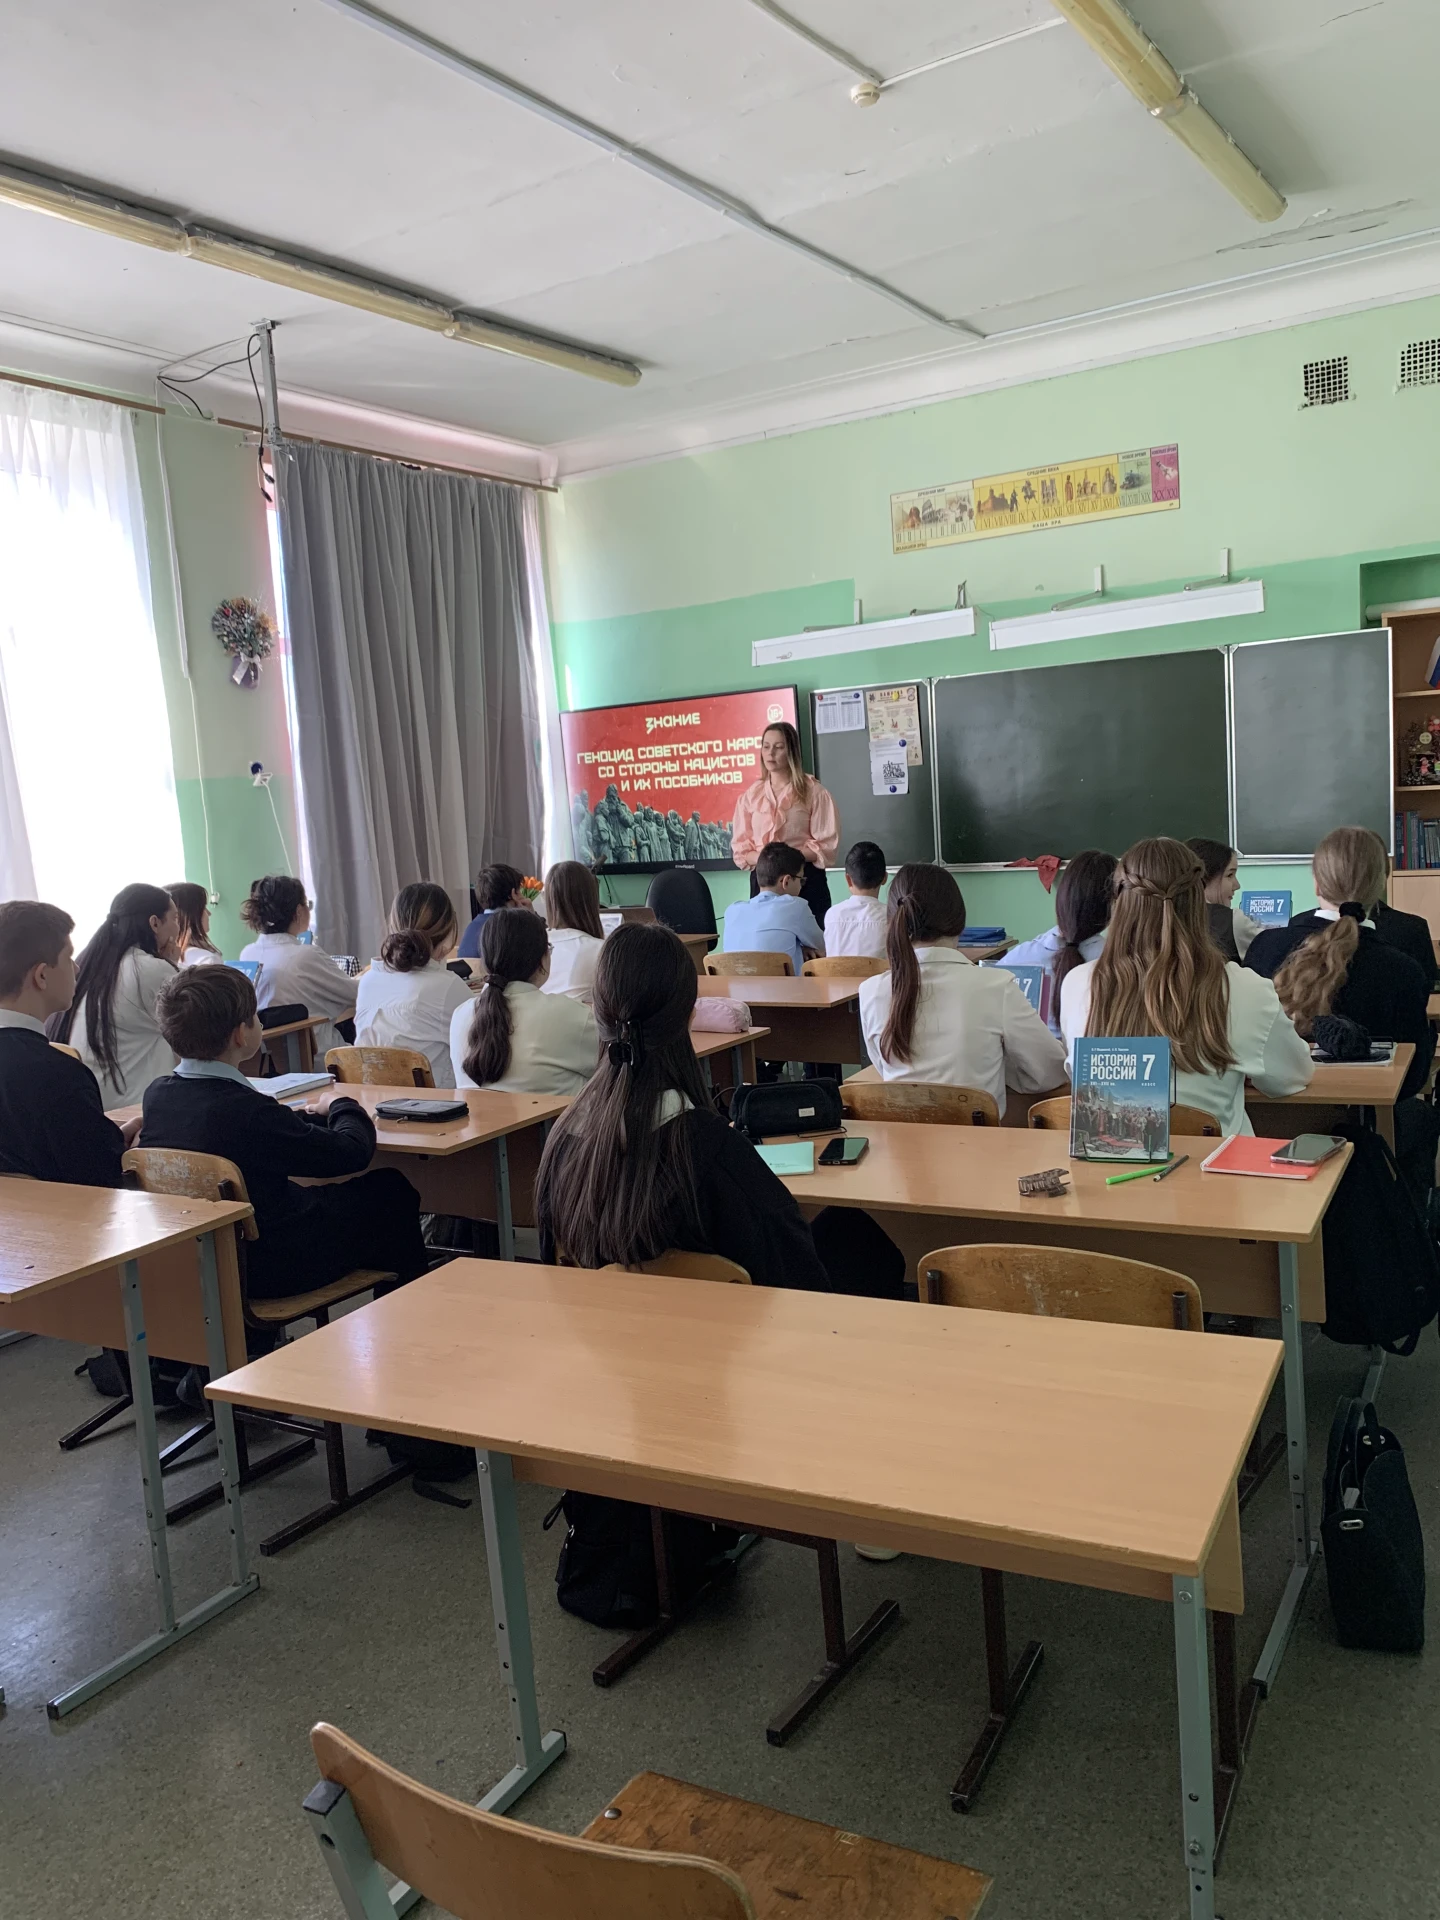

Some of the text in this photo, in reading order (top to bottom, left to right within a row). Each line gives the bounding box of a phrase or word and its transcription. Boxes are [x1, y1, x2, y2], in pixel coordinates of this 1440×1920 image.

[1153, 490, 1164, 501] XX
[1167, 488, 1177, 499] XXI
[576, 735, 762, 765] ГЕНОЦИД СОВЕТСКОГО НАРО
[598, 753, 756, 778] СО СТОРОНЫ НАЦИСТОВ
[621, 771, 743, 792] И ИХ ПОСОБНИКОВ
[1277, 899, 1284, 913] 7
[1023, 978, 1033, 997] 7
[1090, 1054, 1137, 1066] ИСТОРИЯ
[1142, 1054, 1156, 1081] 7
[1090, 1066, 1137, 1080] РОССИИ
